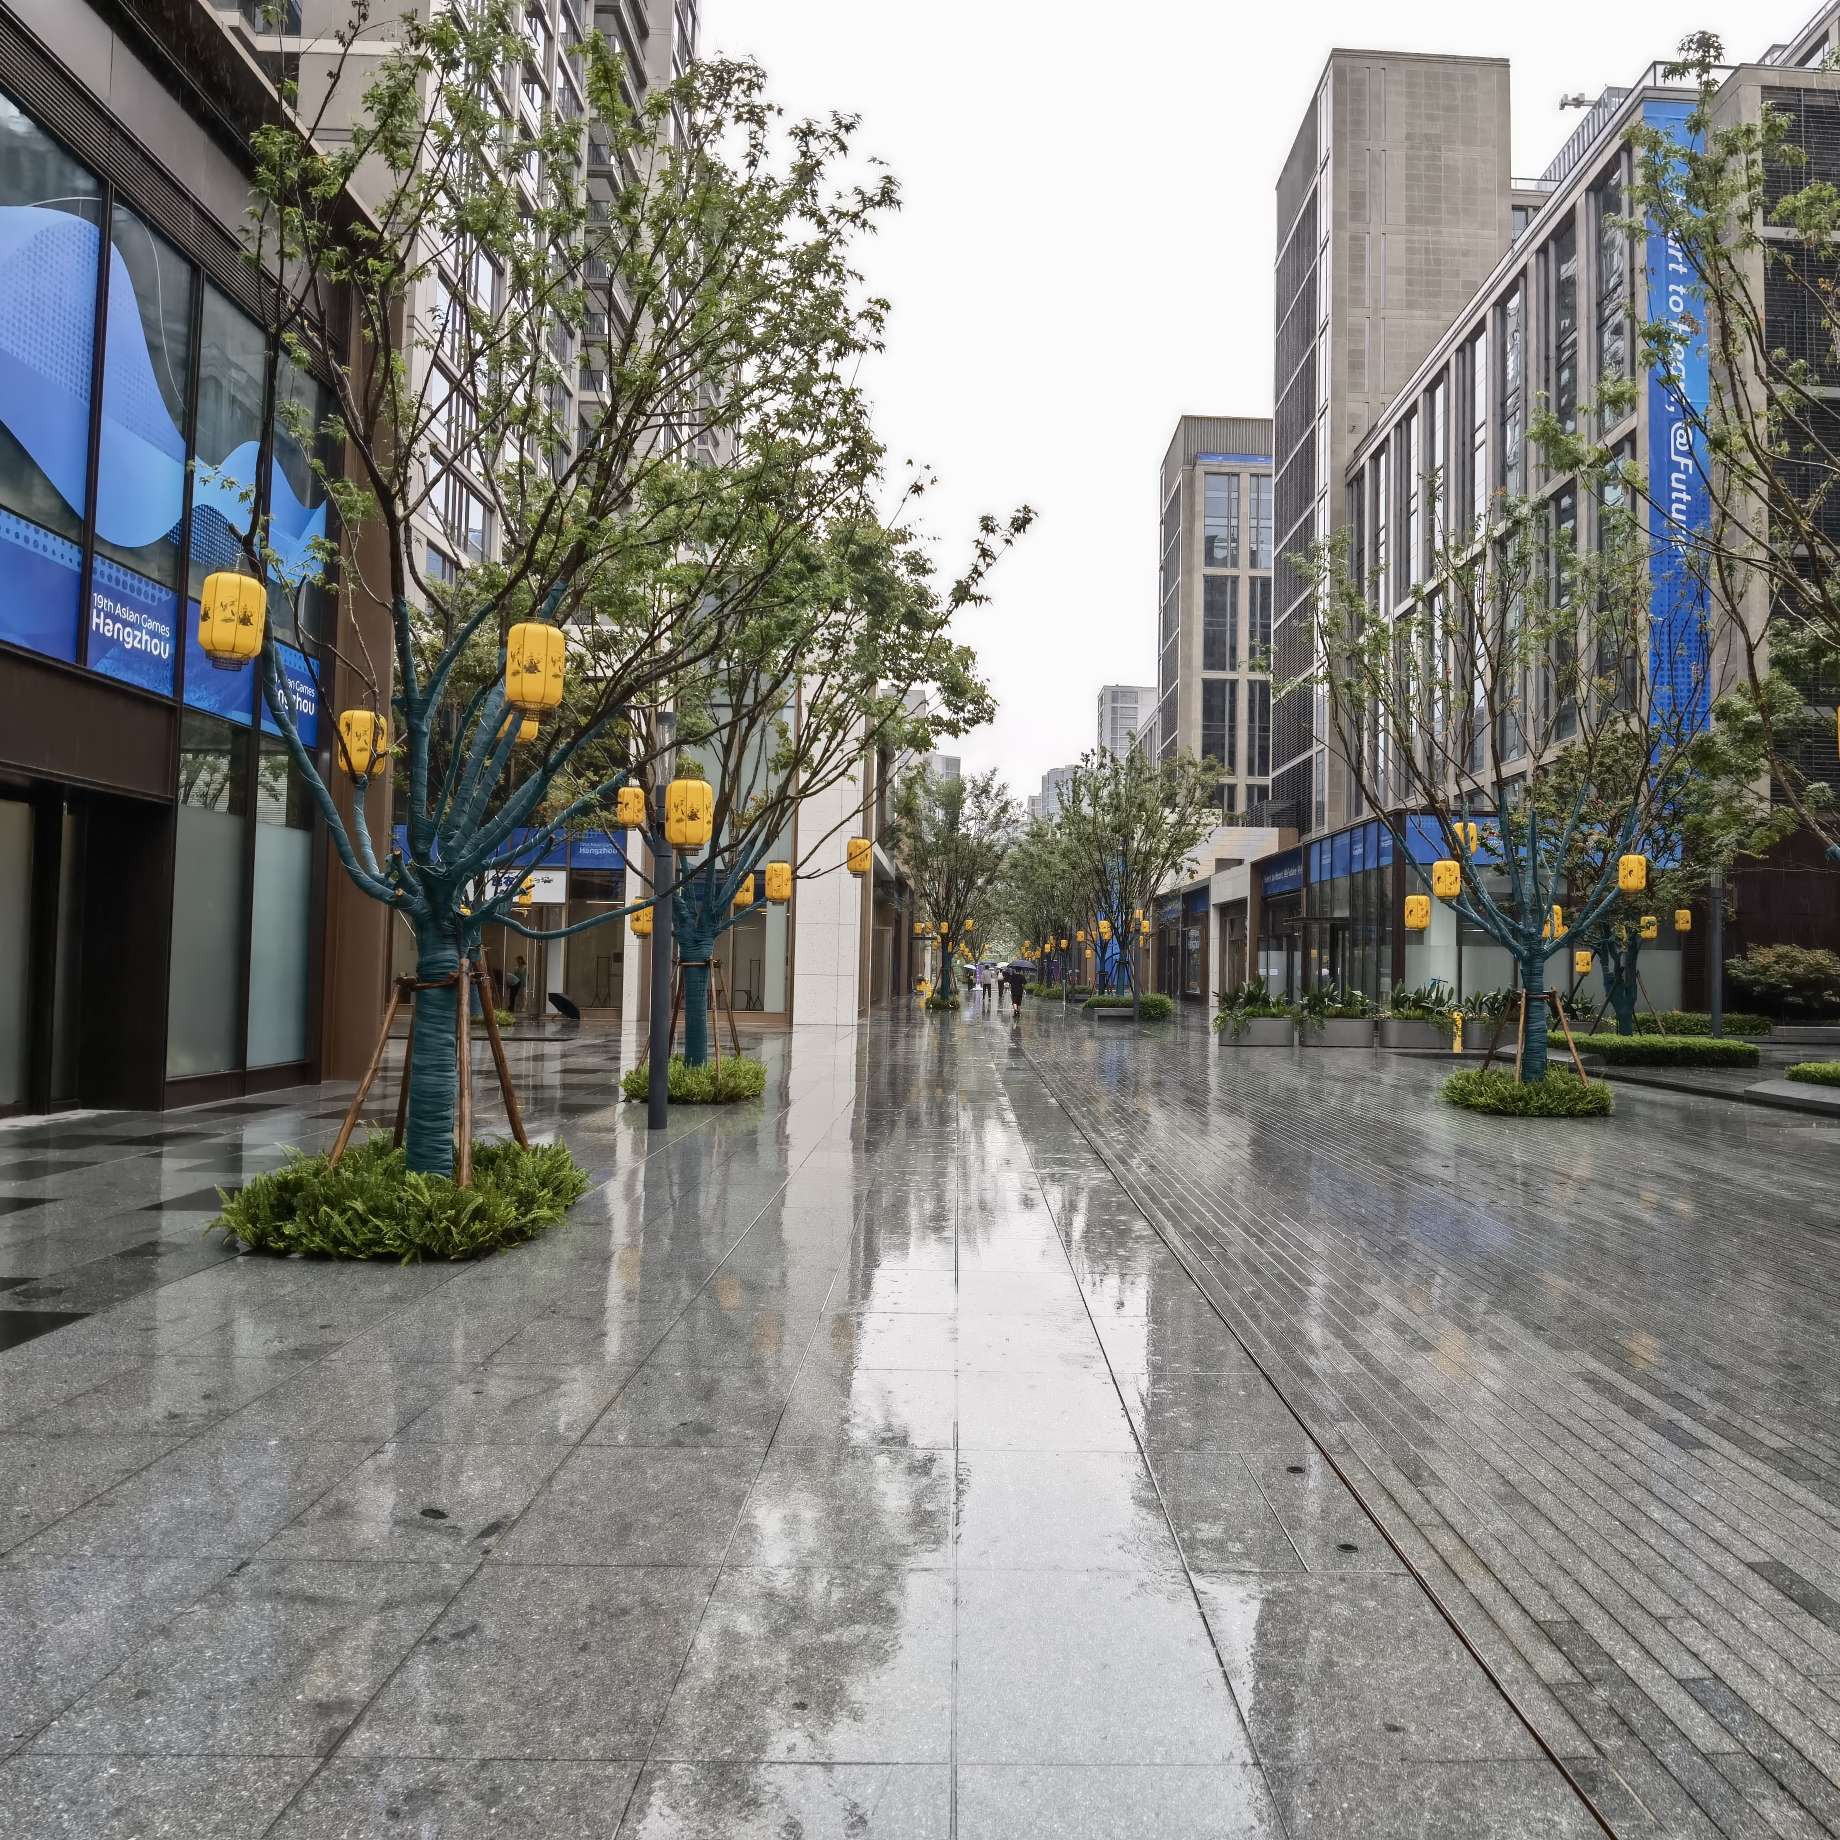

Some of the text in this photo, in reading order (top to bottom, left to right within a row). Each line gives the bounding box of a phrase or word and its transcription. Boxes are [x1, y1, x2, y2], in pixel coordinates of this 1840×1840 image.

[1668, 284, 1688, 313] to
[93, 592, 170, 637] 19th Asian Games
[92, 608, 169, 659] Hangzhou
[295, 680, 315, 698] Games
